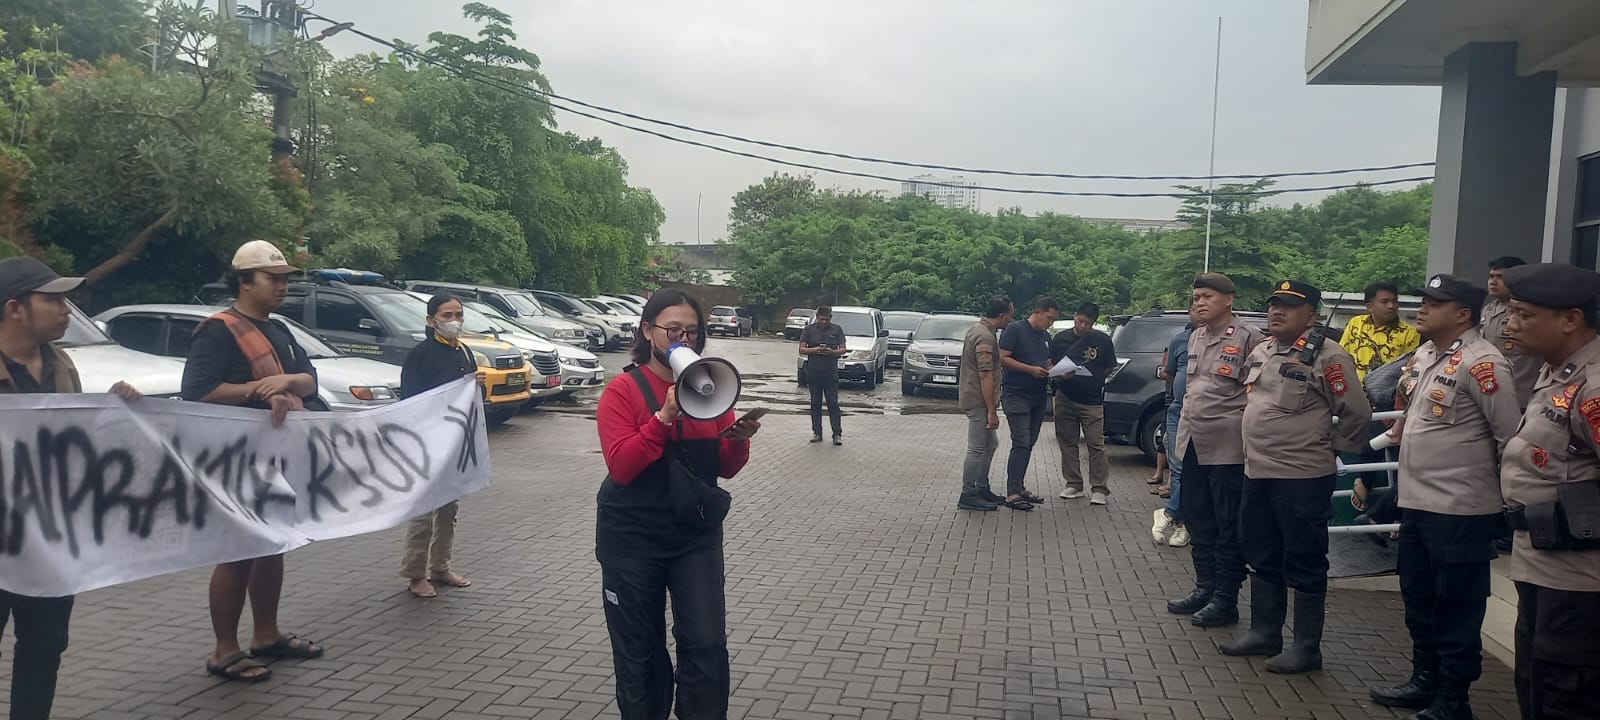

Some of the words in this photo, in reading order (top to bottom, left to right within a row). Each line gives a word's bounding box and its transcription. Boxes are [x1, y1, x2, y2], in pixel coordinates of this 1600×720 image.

[1433, 375, 1457, 389] POLRI
[1540, 406, 1567, 426] POLRI
[306, 423, 430, 522] RSUD
